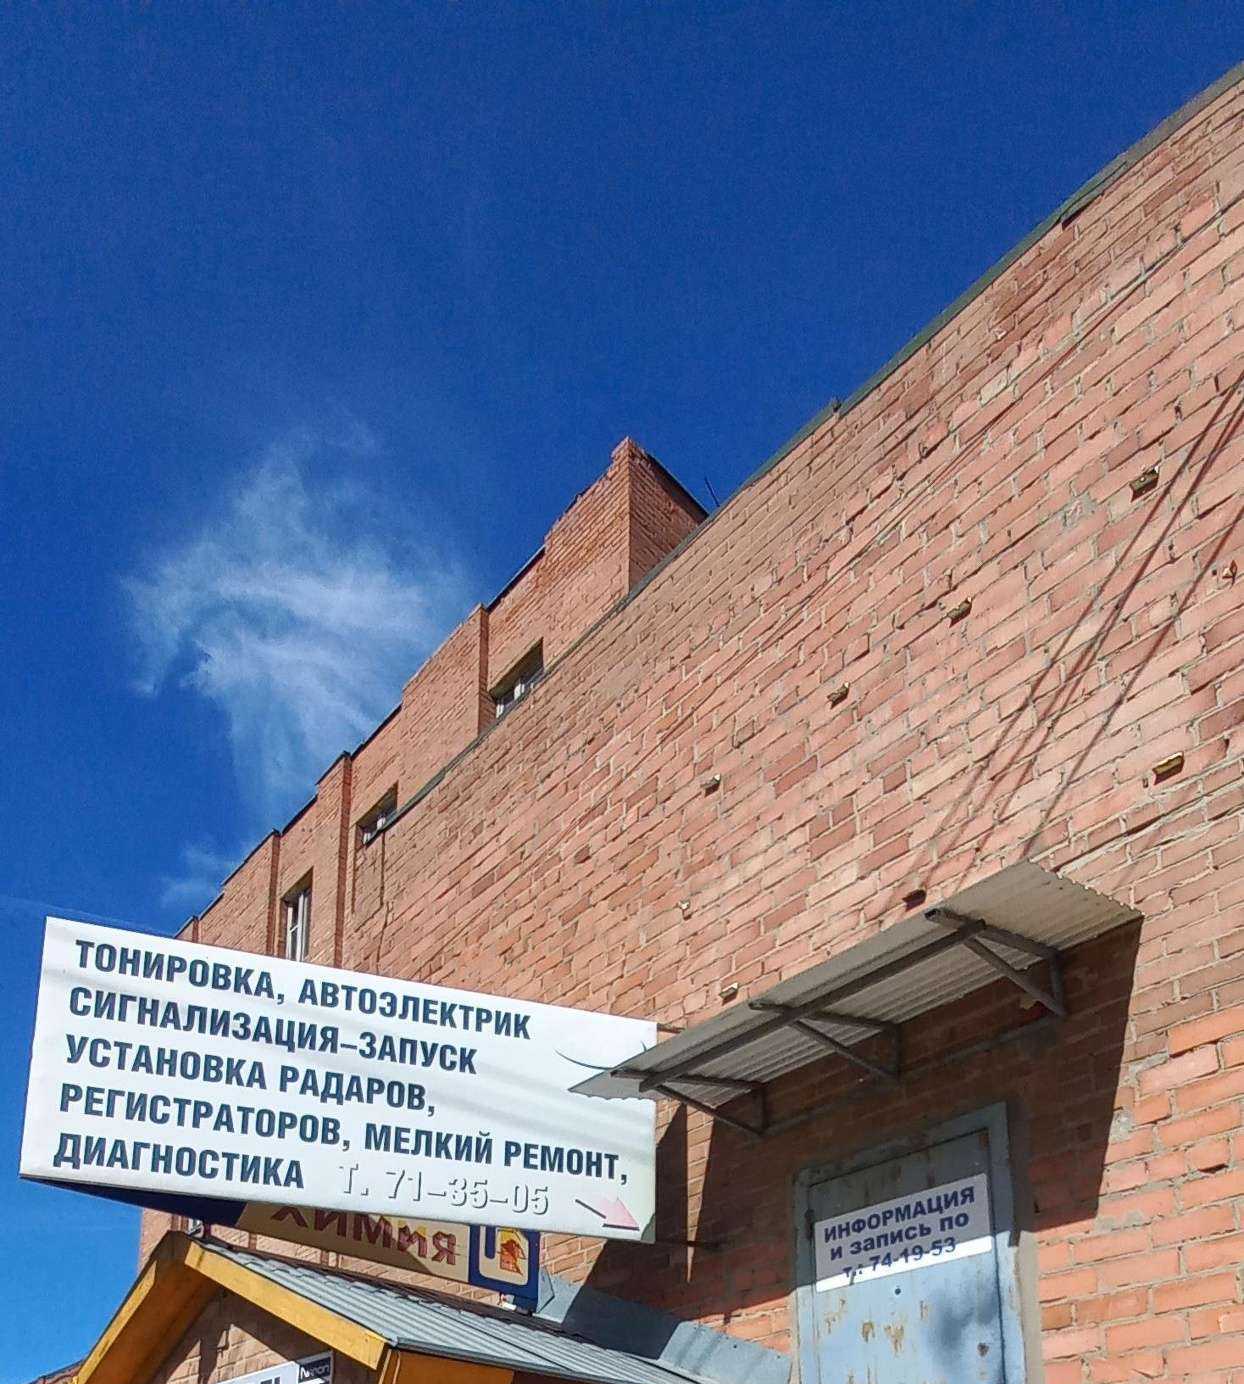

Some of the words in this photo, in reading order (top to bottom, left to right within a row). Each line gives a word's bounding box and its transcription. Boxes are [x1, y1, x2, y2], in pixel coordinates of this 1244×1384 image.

[76, 939, 286, 1004] ТОНИРОВКА,
[298, 979, 531, 1040] АВТОЭЛЕКТРИК
[66, 1034, 267, 1091] УСТАНОВКА
[279, 1065, 436, 1117] РАДАРОВ,
[53, 1133, 305, 1190] ДИАГНОСТИКА
[60, 1083, 352, 1152] РЕГИСТРАТОРОВ,
[364, 1121, 494, 1166] МЕЛКИЙ
[503, 1140, 629, 1185] РЕМОНТ,
[824, 1186, 975, 1243] ИНФОРМАЦИЯ
[830, 1246, 843, 1261] и
[850, 1222, 931, 1255] запись
[940, 1212, 969, 1232] по
[870, 1237, 956, 1271] 74-19-53
